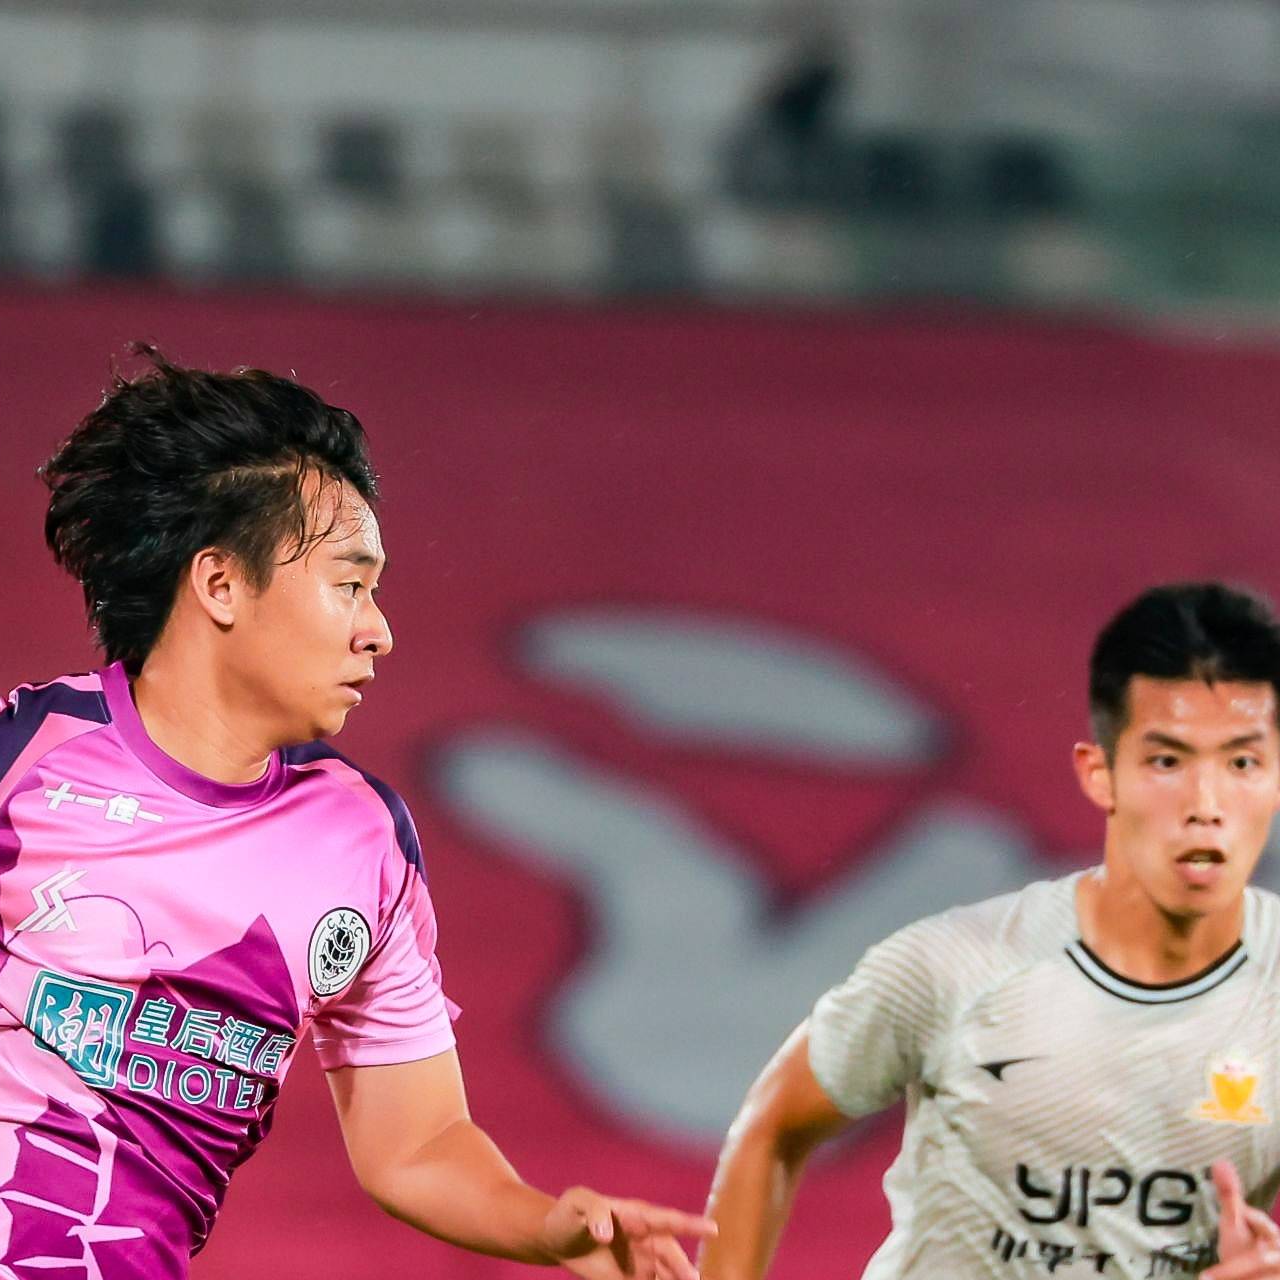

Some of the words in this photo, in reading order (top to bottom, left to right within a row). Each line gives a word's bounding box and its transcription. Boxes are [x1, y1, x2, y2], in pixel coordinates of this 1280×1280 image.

[326, 912, 364, 938] CXFC
[129, 997, 297, 1076] 皇后酒店
